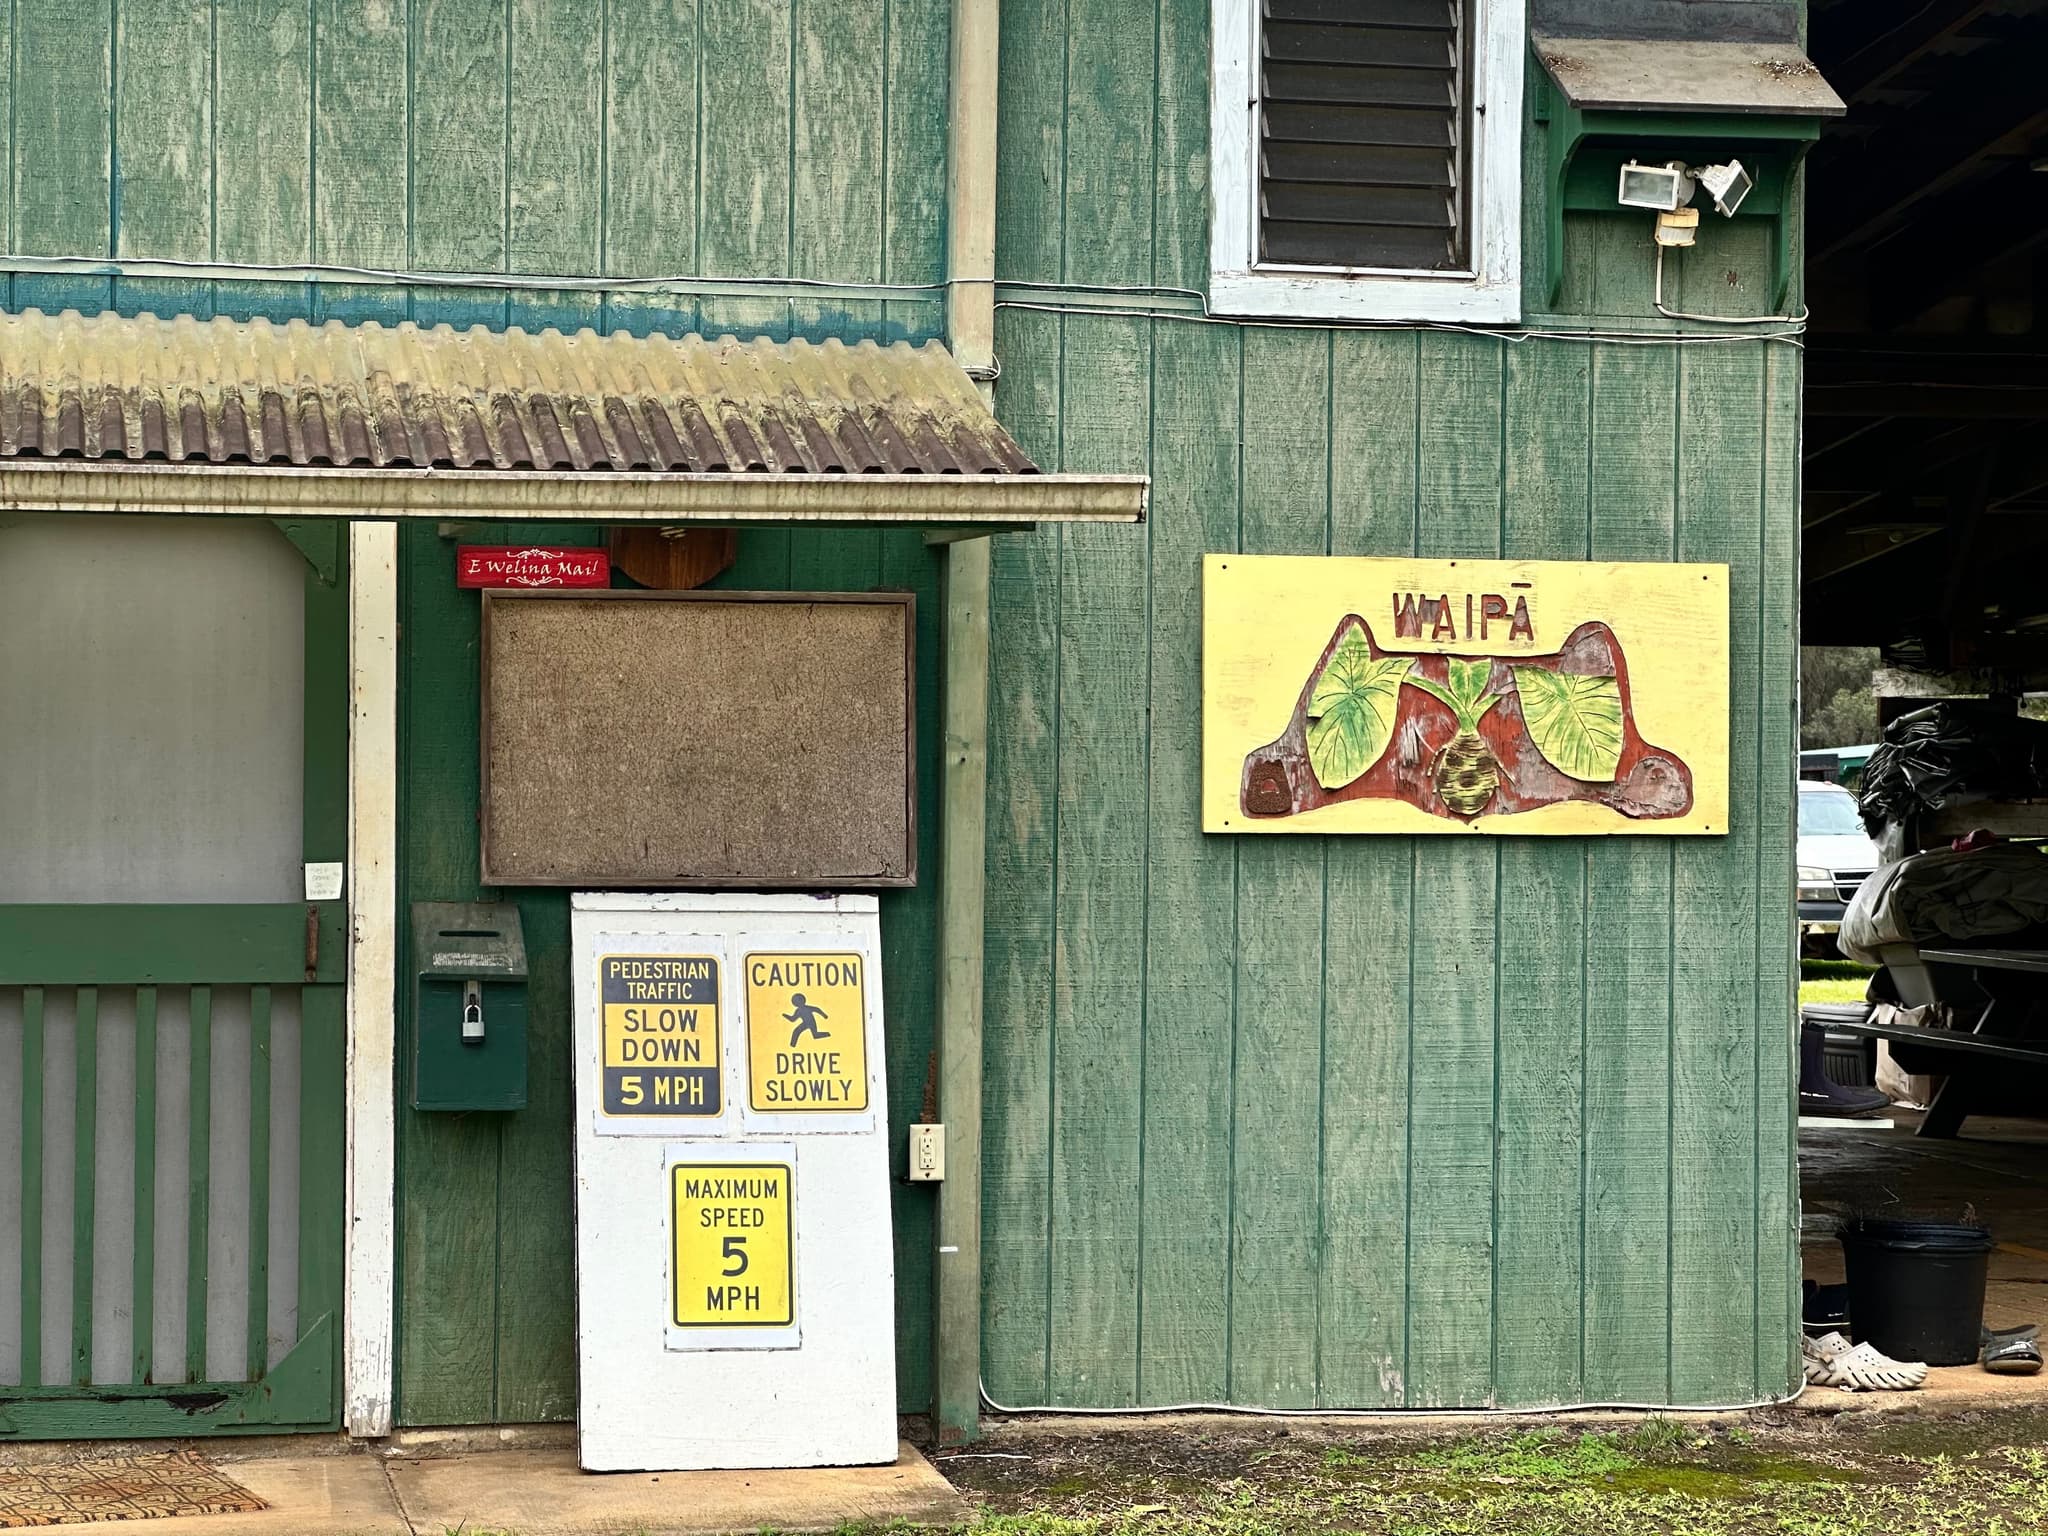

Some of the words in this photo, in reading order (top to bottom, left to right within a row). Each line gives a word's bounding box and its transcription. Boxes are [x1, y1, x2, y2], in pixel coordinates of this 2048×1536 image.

[468, 559, 481, 574] E
[485, 559, 552, 574] Welina
[557, 559, 599, 576] Mai!
[1392, 582, 1535, 641] WAIPĀ
[610, 961, 709, 979] PEDESTRIAN
[752, 962, 857, 987] CAUTION
[627, 982, 692, 999] TRAFFIC
[624, 1009, 698, 1033] SLOW
[622, 1038, 700, 1062] DOWN
[776, 1053, 841, 1074] DRIVE
[621, 1076, 644, 1105] 5
[654, 1076, 704, 1105] MPH
[766, 1079, 852, 1101] SLOWLY
[685, 1179, 778, 1199] MAXIMUM
[700, 1208, 765, 1227] SPEED
[721, 1236, 749, 1277] 5
[707, 1286, 760, 1311] MPH
